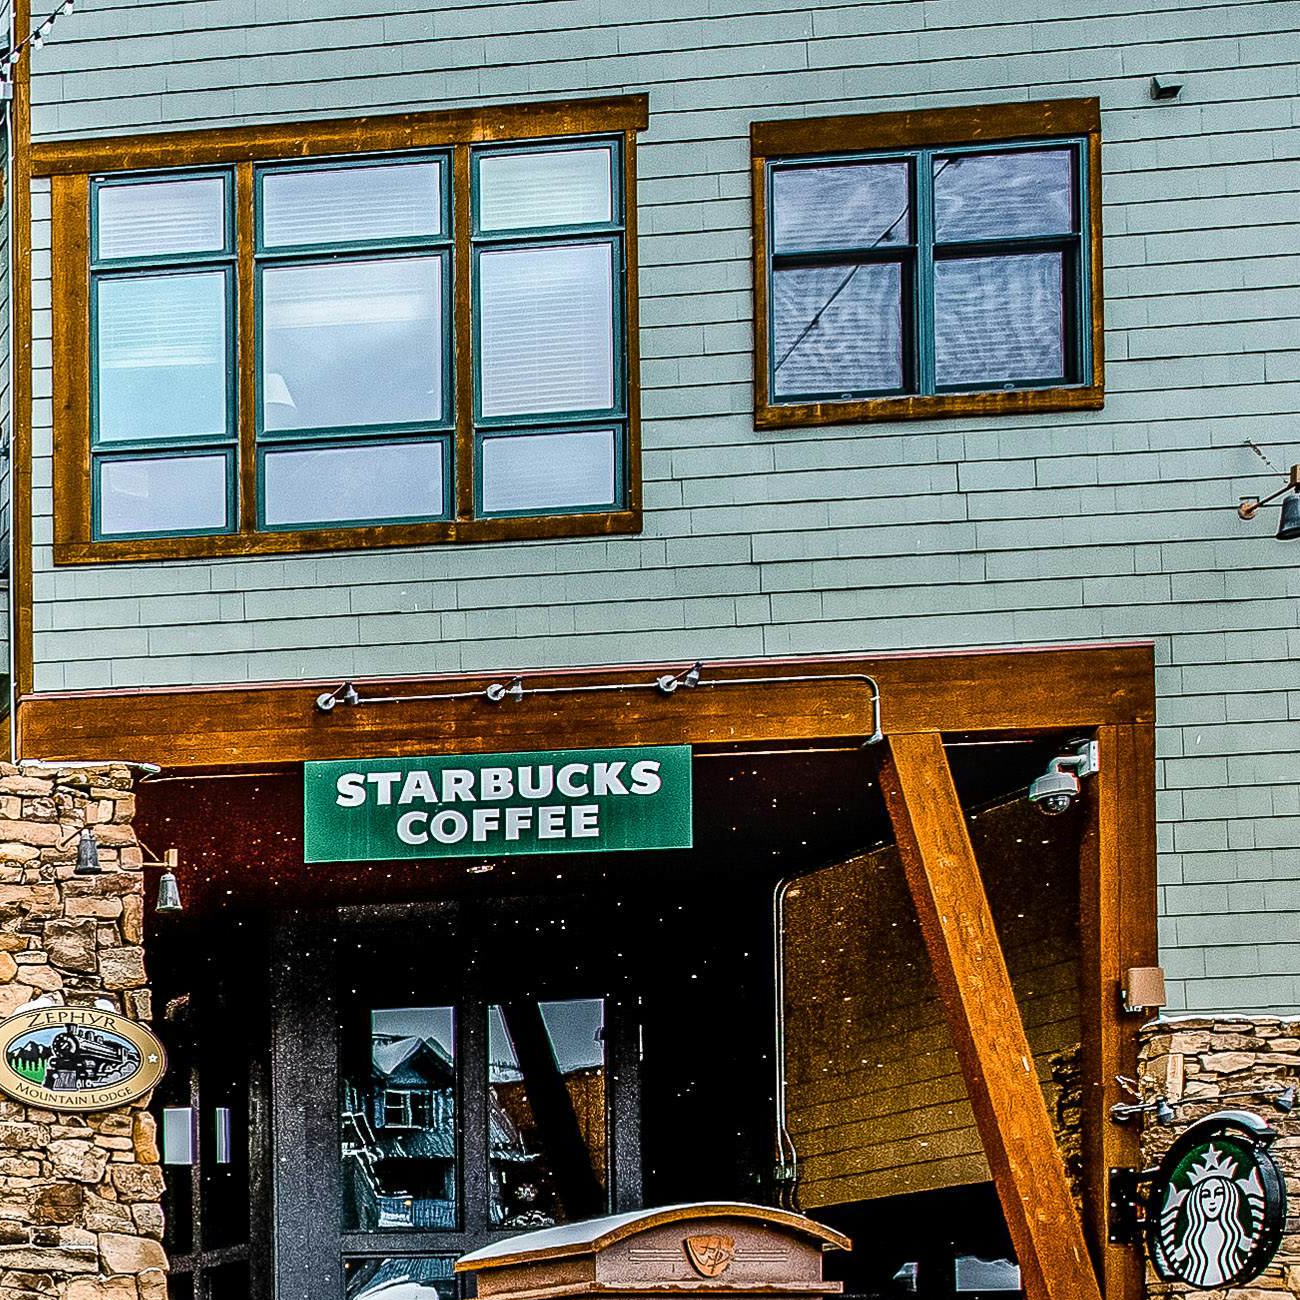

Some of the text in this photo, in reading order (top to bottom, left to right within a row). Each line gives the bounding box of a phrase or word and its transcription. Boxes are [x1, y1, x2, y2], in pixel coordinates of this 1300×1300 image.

[336, 760, 662, 807] STARBUCKS
[397, 805, 600, 845] COFFEE
[26, 1011, 119, 1031] ZEPHYR
[15, 1082, 133, 1105] MOUNTAIN LODGE
